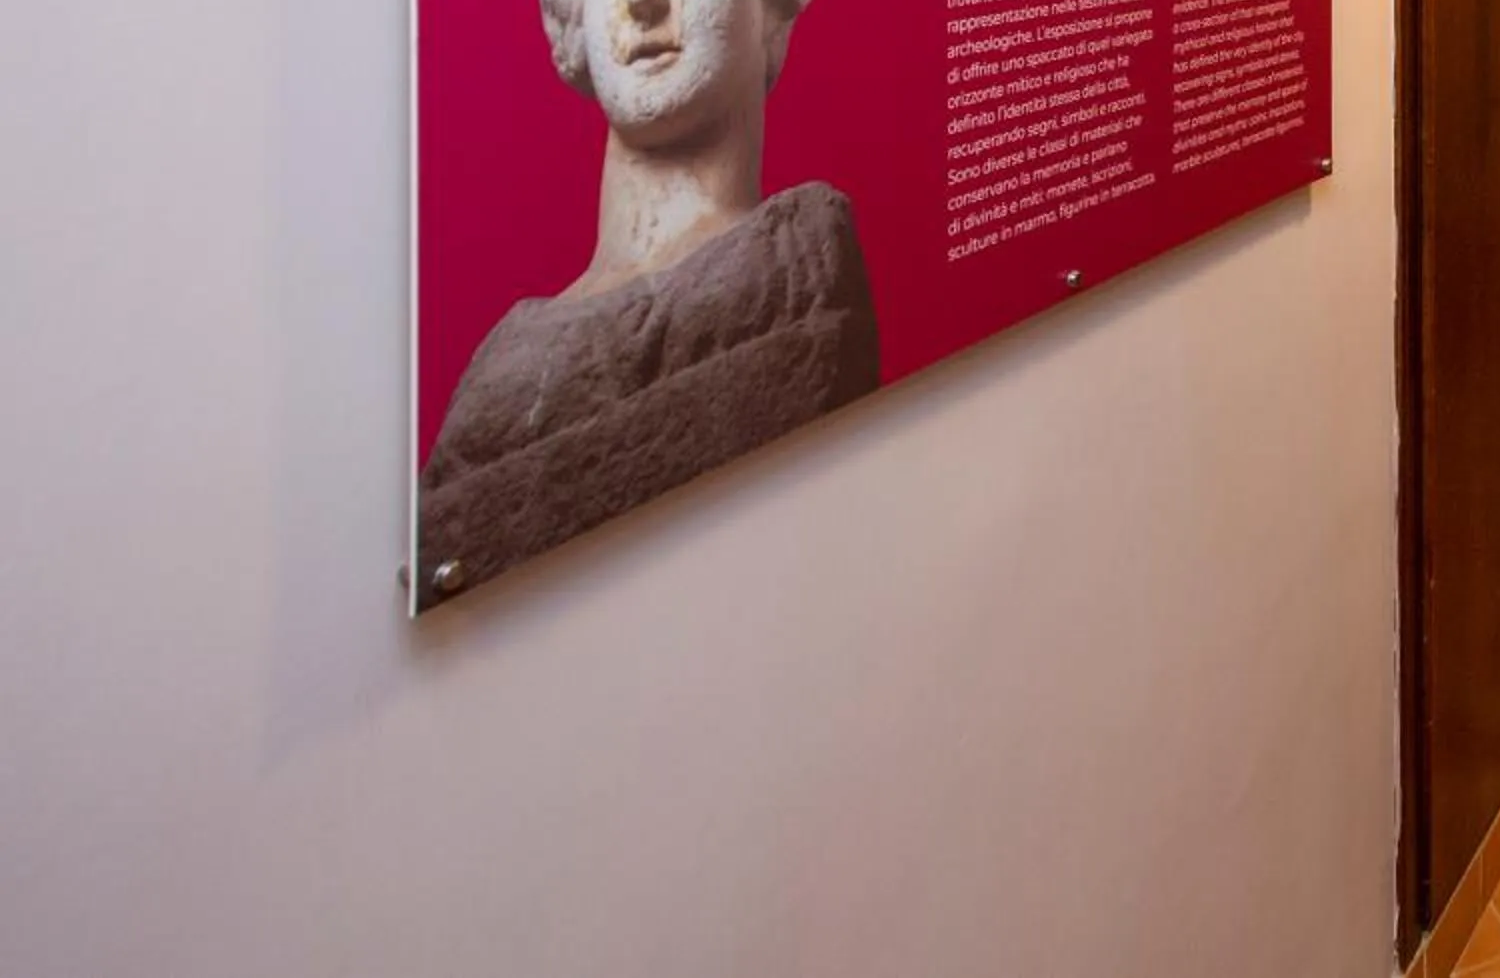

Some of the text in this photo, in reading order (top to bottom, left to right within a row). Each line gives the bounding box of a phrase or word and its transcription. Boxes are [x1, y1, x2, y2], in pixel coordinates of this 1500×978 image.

[962, 62, 999, 82] offrire
[947, 86, 1004, 111] orizzonte
[947, 112, 995, 136] definito
[947, 127, 1025, 161] recuperando
[947, 166, 980, 187] Sono
[948, 178, 1018, 212] conservano
[963, 202, 1008, 231] divinità
[948, 233, 998, 262] sculture
